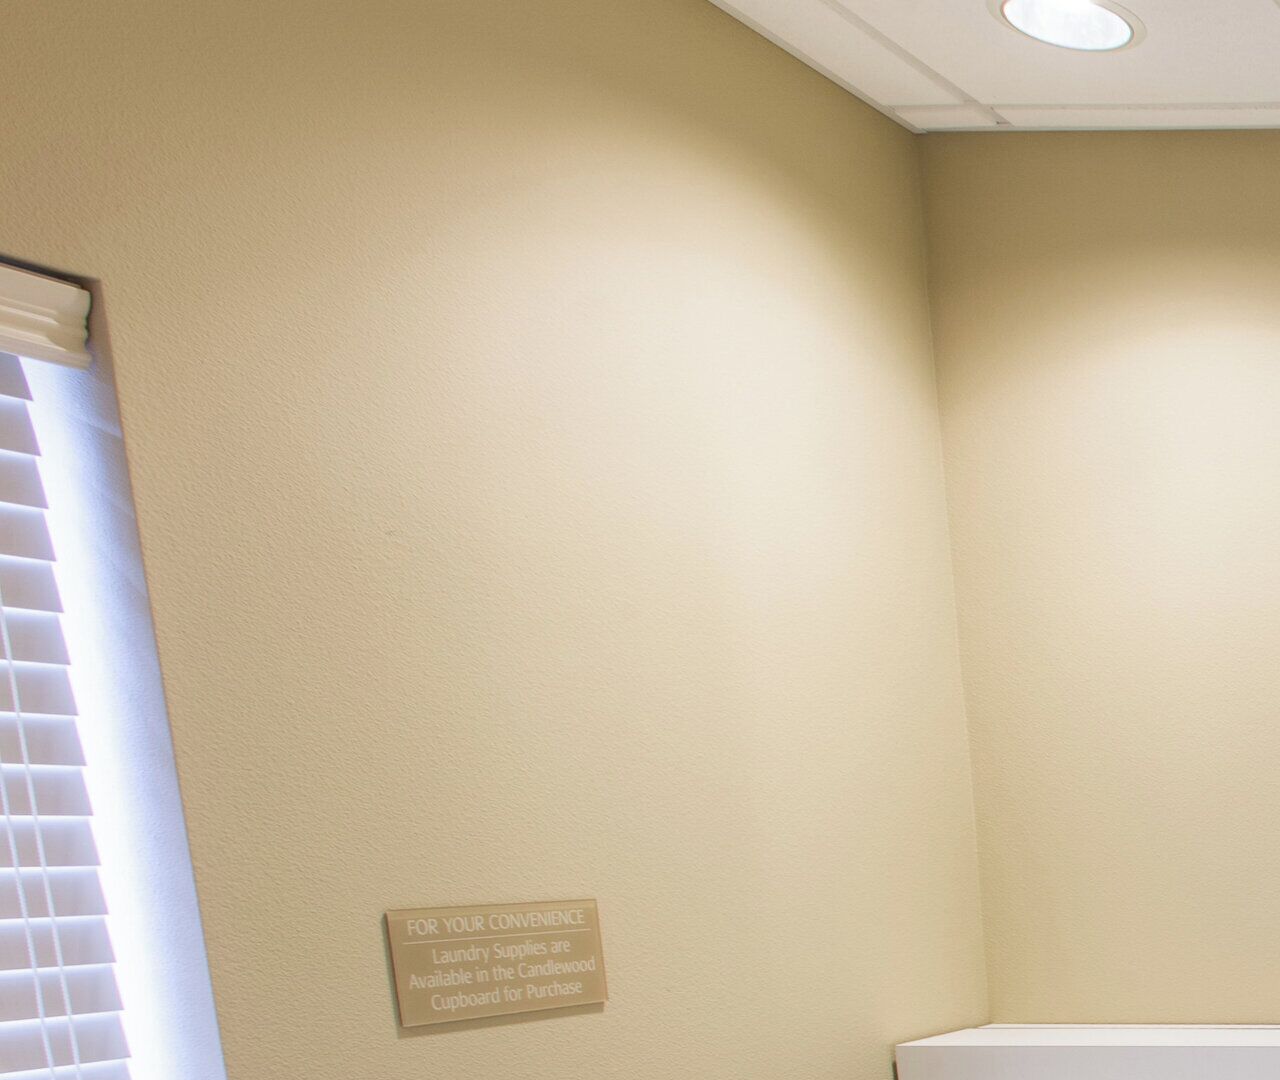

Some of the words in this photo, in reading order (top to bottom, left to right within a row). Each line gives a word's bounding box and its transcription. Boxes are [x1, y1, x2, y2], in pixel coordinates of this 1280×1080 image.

[406, 918, 439, 936] FOR
[443, 915, 484, 934] YOUR
[488, 908, 585, 931] CONVENIENCE
[431, 943, 489, 965] Laundry
[494, 940, 547, 960] Supplies
[551, 939, 571, 954] are
[409, 971, 473, 990] Available
[476, 967, 489, 983] in
[492, 965, 514, 981] the
[518, 956, 596, 979] Candlewood
[430, 988, 501, 1012] Cupboard
[503, 986, 523, 1001] for
[527, 980, 583, 1000] Purchase
